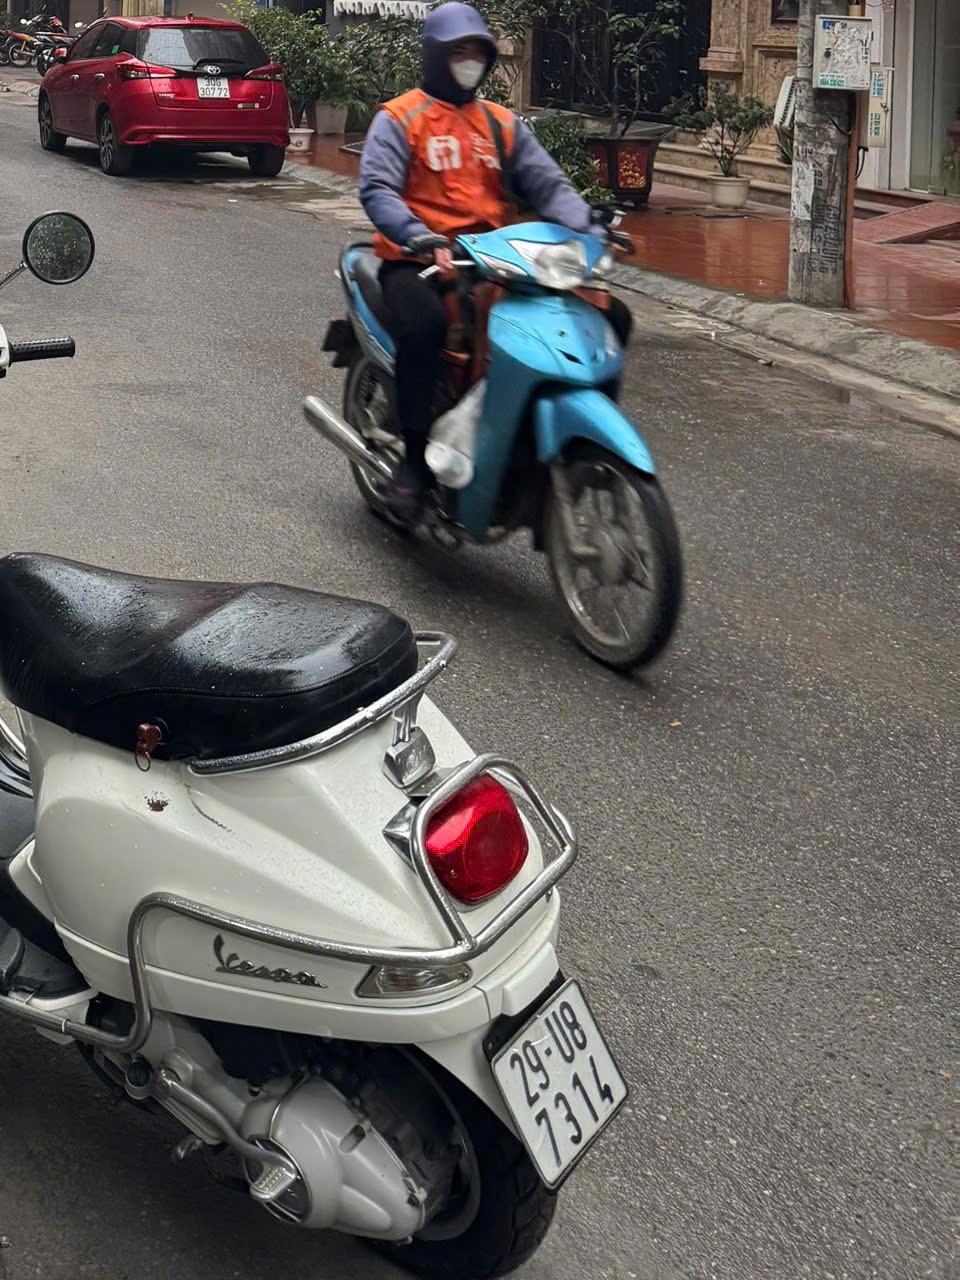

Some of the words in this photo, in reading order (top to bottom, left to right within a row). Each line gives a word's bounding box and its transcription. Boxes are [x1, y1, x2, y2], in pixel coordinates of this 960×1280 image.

[213, 933, 328, 988] Vespa
[510, 1001, 587, 1108] 29-U8
[535, 1054, 614, 1168] 7314
